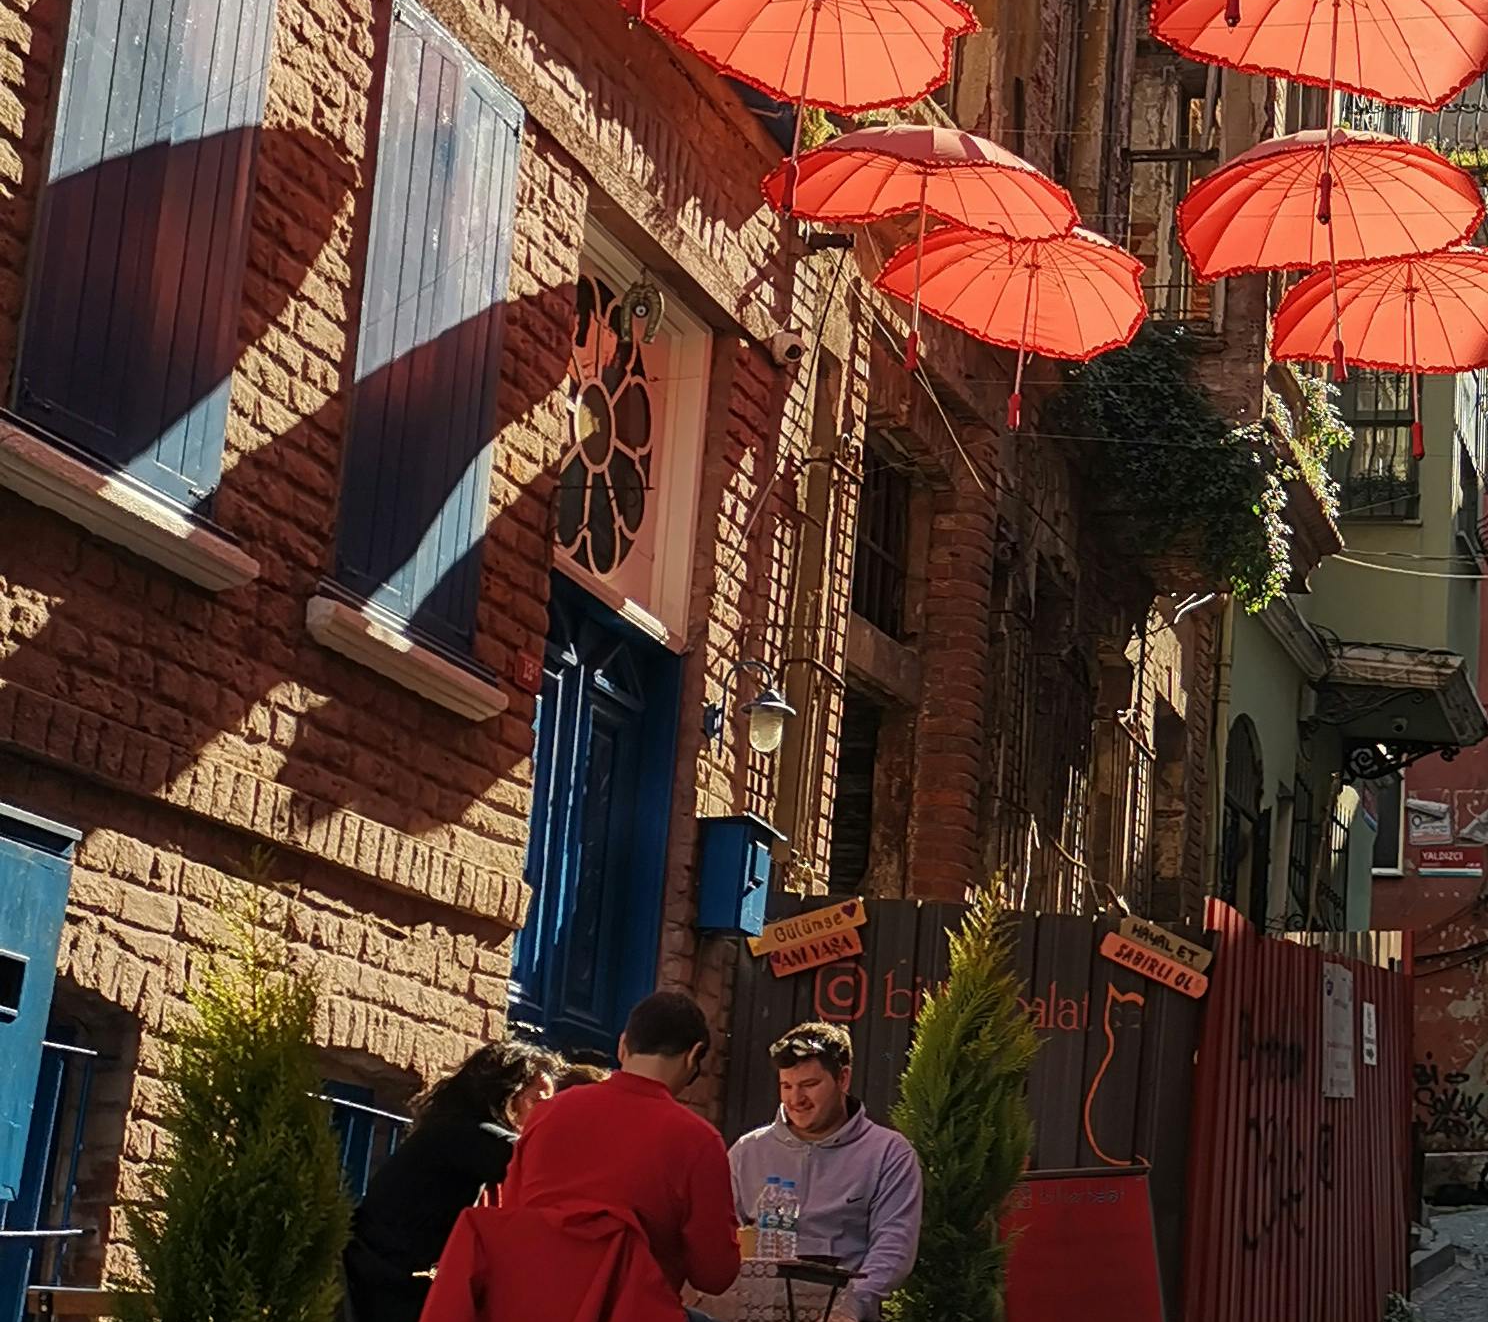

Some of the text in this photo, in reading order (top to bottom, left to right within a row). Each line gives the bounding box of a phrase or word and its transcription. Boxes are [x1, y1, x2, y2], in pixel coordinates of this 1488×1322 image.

[774, 911, 843, 944] Gülümse
[1131, 923, 1200, 963] HAYAL ET
[781, 935, 854, 969] ANI YAŞA
[1114, 943, 1194, 991] SABIRLI OL
